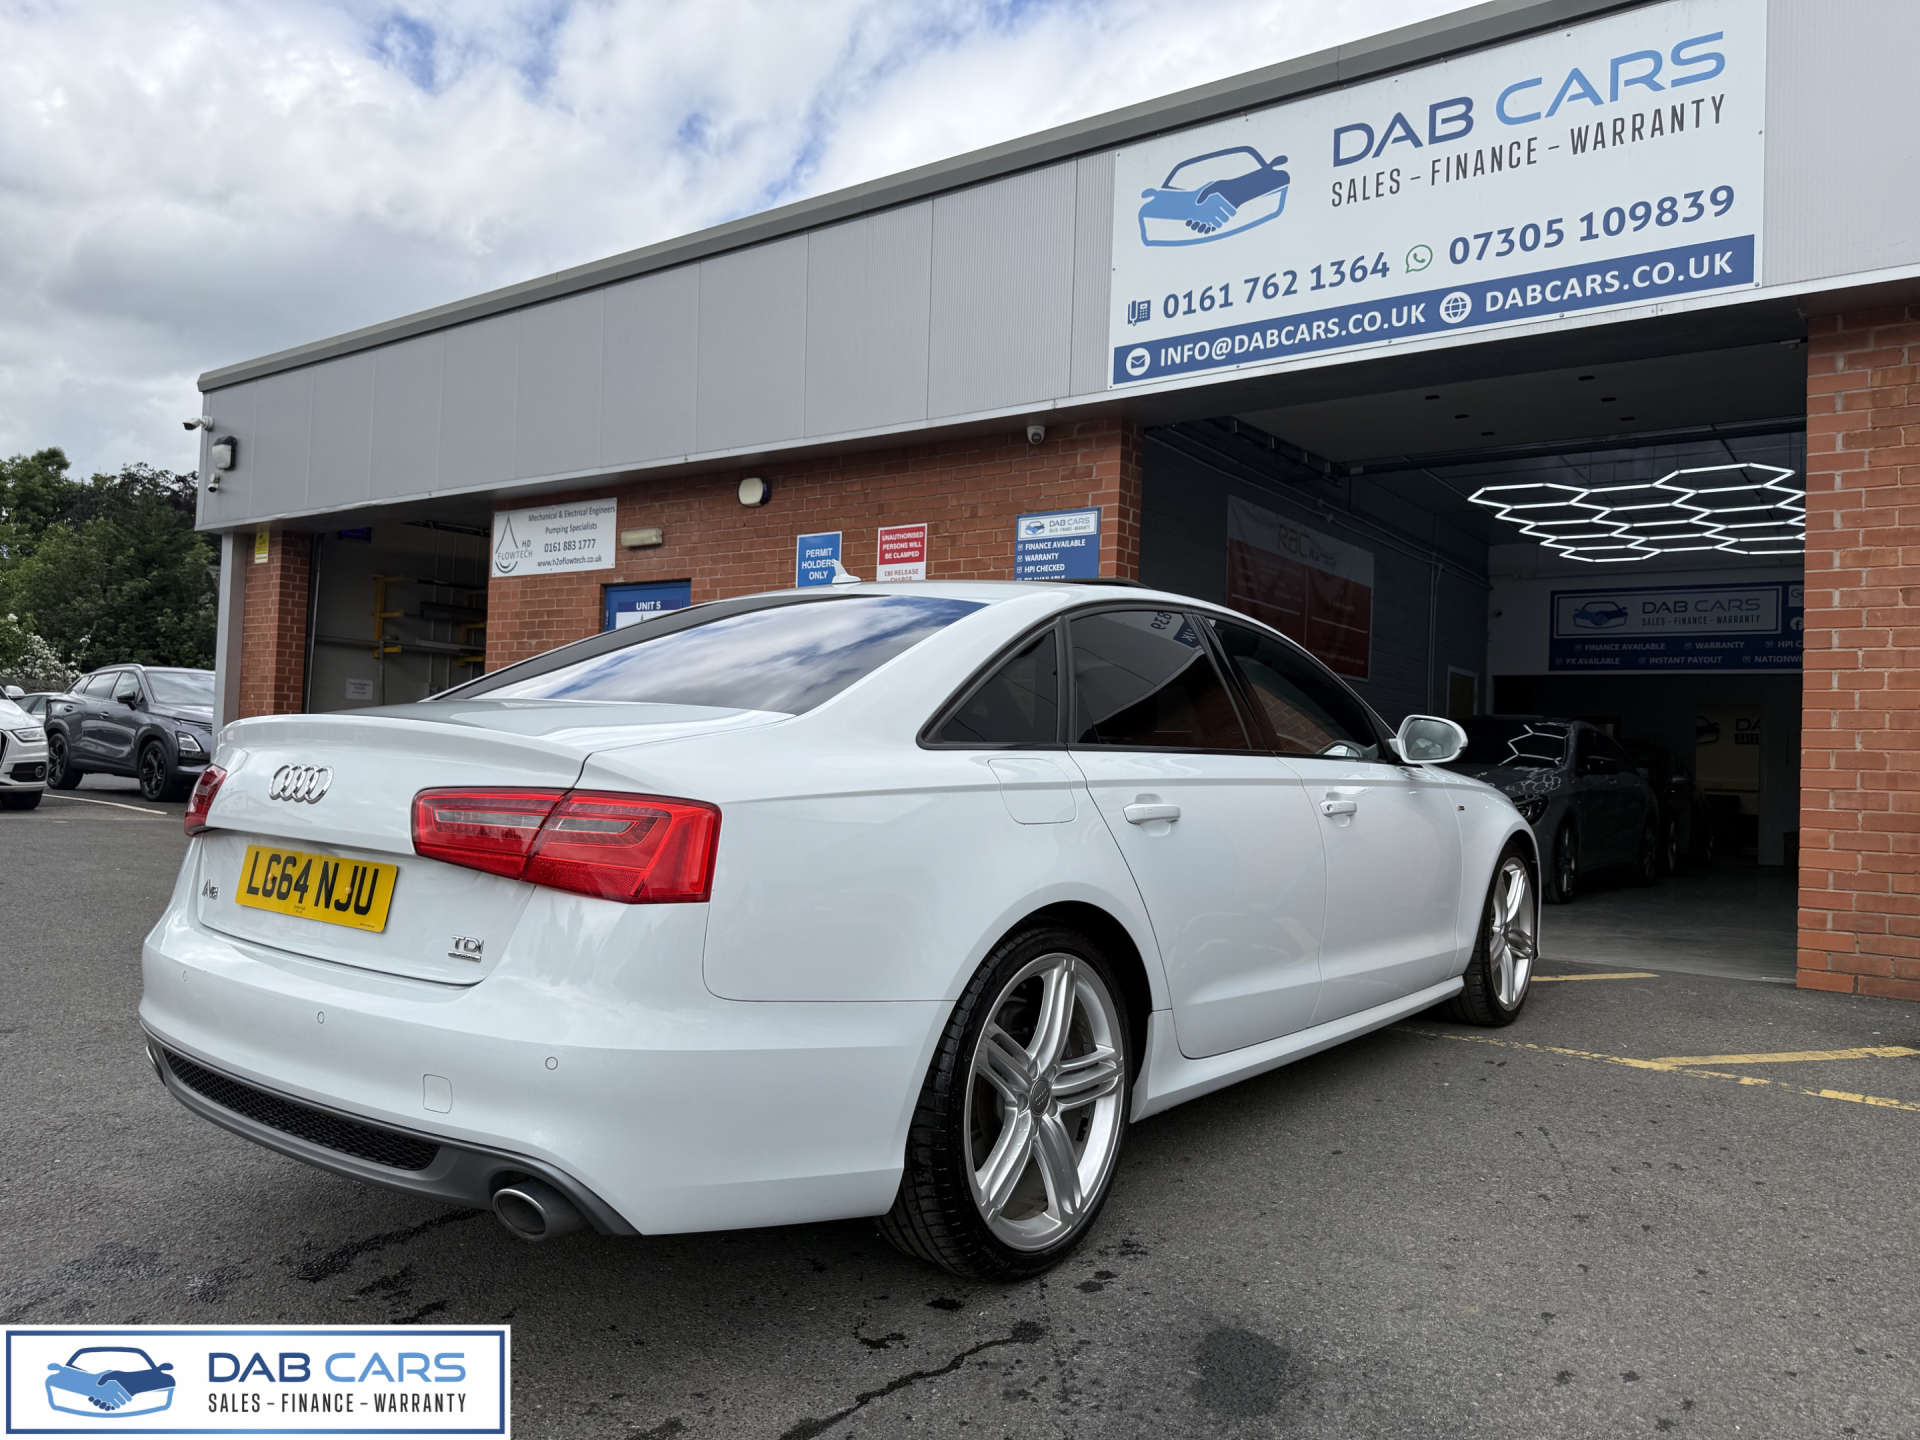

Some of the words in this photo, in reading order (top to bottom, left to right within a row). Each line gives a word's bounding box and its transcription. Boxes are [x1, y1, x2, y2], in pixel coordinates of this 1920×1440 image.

[1333, 96, 1474, 168] DAB
[1495, 31, 1726, 126] CARS
[1331, 168, 1401, 207] SALES
[1431, 137, 1538, 186] FINANCE
[1570, 93, 1725, 155] WARRANTY
[1449, 217, 1565, 265] 07305
[1578, 185, 1735, 242] 109839
[1162, 282, 1234, 319] 0161
[1243, 269, 1298, 304] 762
[1309, 251, 1390, 291] 1364
[1485, 251, 1733, 313] DABCARS.CO.UK
[1160, 302, 1426, 367] INFO@DABCARS.CO.UK
[528, 510, 557, 522] Mechanical
[588, 506, 616, 517] Engineers
[545, 525, 568, 535] Pumping
[569, 522, 598, 533] Specialists
[1050, 520, 1066, 528] DAB
[1068, 517, 1090, 526] CARS
[544, 543, 560, 553] 0161
[563, 540, 576, 551] 883
[578, 539, 596, 550] 1777
[1026, 542, 1052, 550] FINANCE
[1052, 539, 1086, 548] AVAILABLE
[498, 550, 533, 560] FLOWTECH
[806, 548, 832, 558] PERMIT
[884, 552, 892, 560] BE
[893, 550, 920, 558] CLAMPED
[1024, 552, 1060, 562] WARRANTY
[802, 558, 835, 570] HOLDERS
[1036, 564, 1066, 572] CHECKED
[808, 571, 828, 580] ONLY
[636, 602, 655, 610] UNIT
[656, 600, 662, 610] 5
[1642, 600, 1688, 614] DAB
[1694, 598, 1761, 612] CARS
[1673, 616, 1708, 626] FINANCE
[1716, 614, 1761, 625] WARRANTY
[1650, 656, 1684, 664] INSTANT
[1688, 656, 1722, 664] PAYOUT
[246, 851, 312, 904] LG64
[313, 861, 379, 916] NJU
[451, 936, 484, 954] TDI
